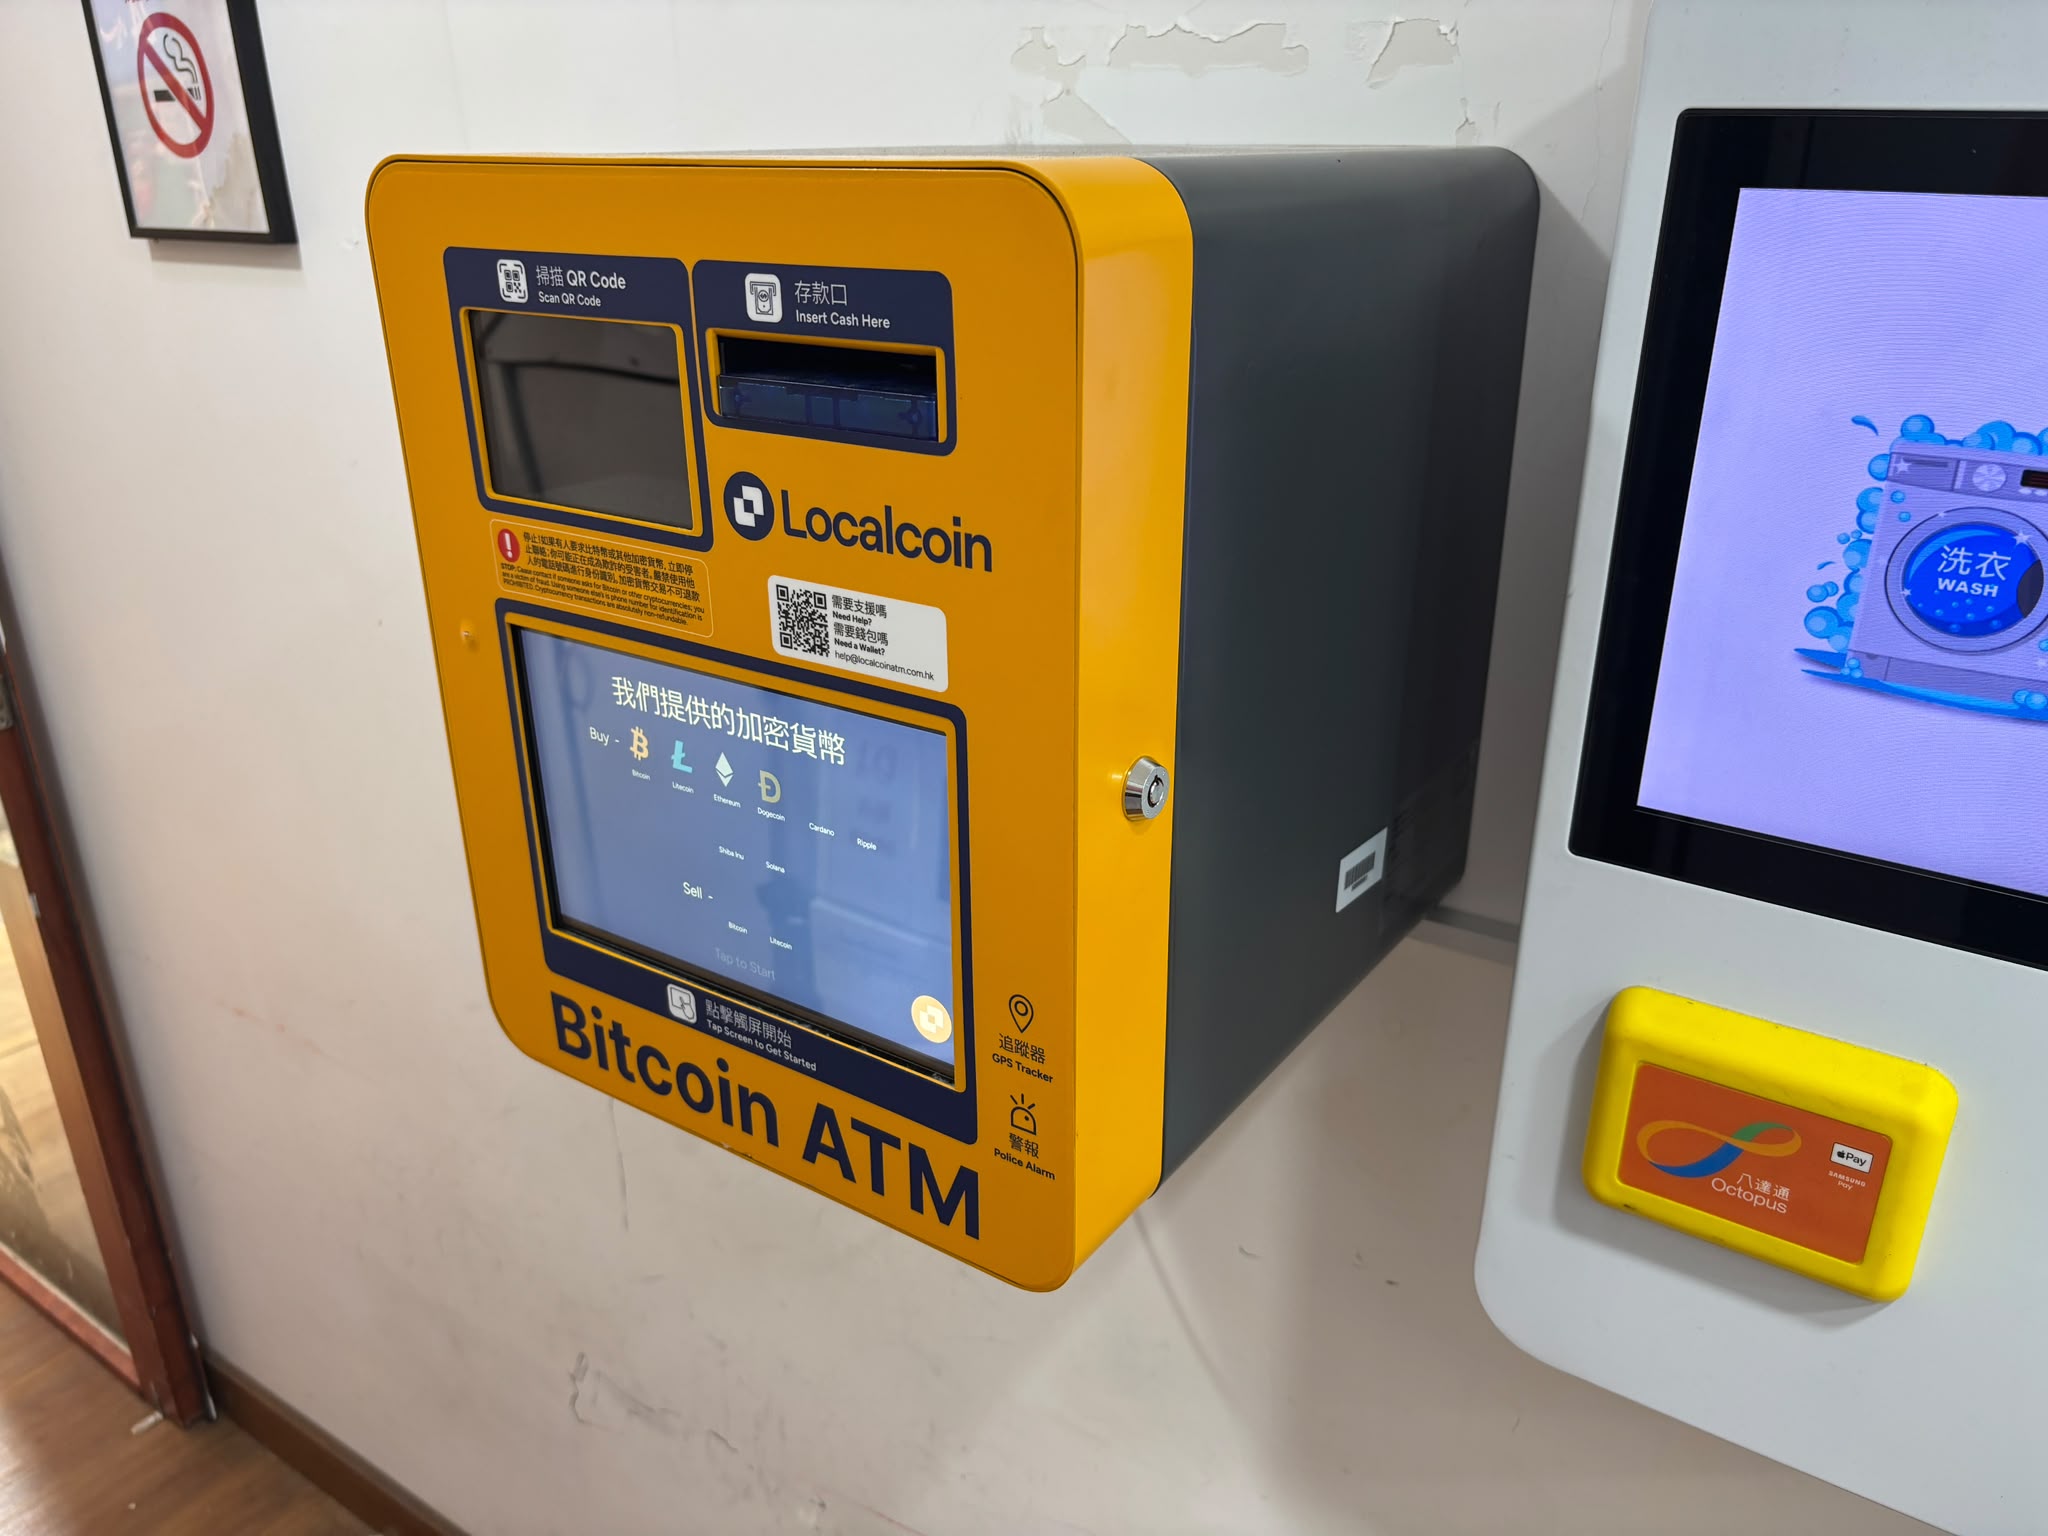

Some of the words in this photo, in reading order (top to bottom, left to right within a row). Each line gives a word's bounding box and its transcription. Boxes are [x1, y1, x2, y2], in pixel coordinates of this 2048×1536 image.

[536, 265, 564, 287] 掃描
[566, 269, 587, 287] QR
[590, 271, 626, 290] Code
[538, 290, 560, 304] Scan
[561, 292, 575, 305] QR
[577, 294, 602, 307] Code
[794, 280, 848, 306] 存款口
[796, 309, 828, 324] Insert
[830, 311, 859, 327] Cash
[861, 313, 890, 329] Here
[781, 489, 992, 572] Localcoin
[1937, 545, 2011, 581] 洗衣
[1937, 577, 1999, 598] WASH
[832, 594, 888, 619] 需要支援嗎
[832, 611, 851, 622] Need
[852, 614, 872, 627] Help?
[833, 621, 889, 647] 需要錢包嗎
[834, 638, 853, 649] Need
[859, 642, 886, 656] Wallet?
[834, 650, 935, 681] help@localcoinatm.com.hk
[611, 676, 846, 766] 我們提供的加密貨幣
[589, 726, 610, 746] Buy
[632, 769, 651, 781] Bitcoin
[672, 781, 695, 794] Litecoin
[713, 793, 741, 808] Ethereum
[757, 807, 786, 822] Dogecoin
[809, 821, 835, 837] Cardano
[719, 845, 735, 857] Shiba
[857, 837, 877, 851] Ripple
[765, 860, 786, 874] Solana
[683, 881, 703, 900] Sell
[728, 921, 748, 934] Bitcoin
[769, 936, 793, 950] Litecoin
[715, 947, 734, 965] Tap
[735, 957, 748, 969] to
[749, 960, 776, 981] Start
[705, 998, 792, 1050] 點擊觸屏開始
[706, 1018, 723, 1035] Tap
[723, 1025, 754, 1045] Screen
[754, 1037, 765, 1050] to
[765, 1043, 782, 1058] Get
[783, 1050, 818, 1072] Started
[999, 1032, 1046, 1065] 追蹤器
[992, 1052, 1014, 1069] GPS
[1015, 1060, 1054, 1083] Tracker
[550, 991, 779, 1148] Bitcoin
[802, 1102, 980, 1240] ATM
[1009, 1132, 1040, 1160] 警報
[994, 1148, 1024, 1168] Police
[1025, 1160, 1056, 1181] Alarm
[1845, 1152, 1867, 1167] Pay
[1736, 1172, 1791, 1201] 八達通
[1828, 1170, 1866, 1188] SAMSUNG
[1711, 1176, 1788, 1214] Octopus
